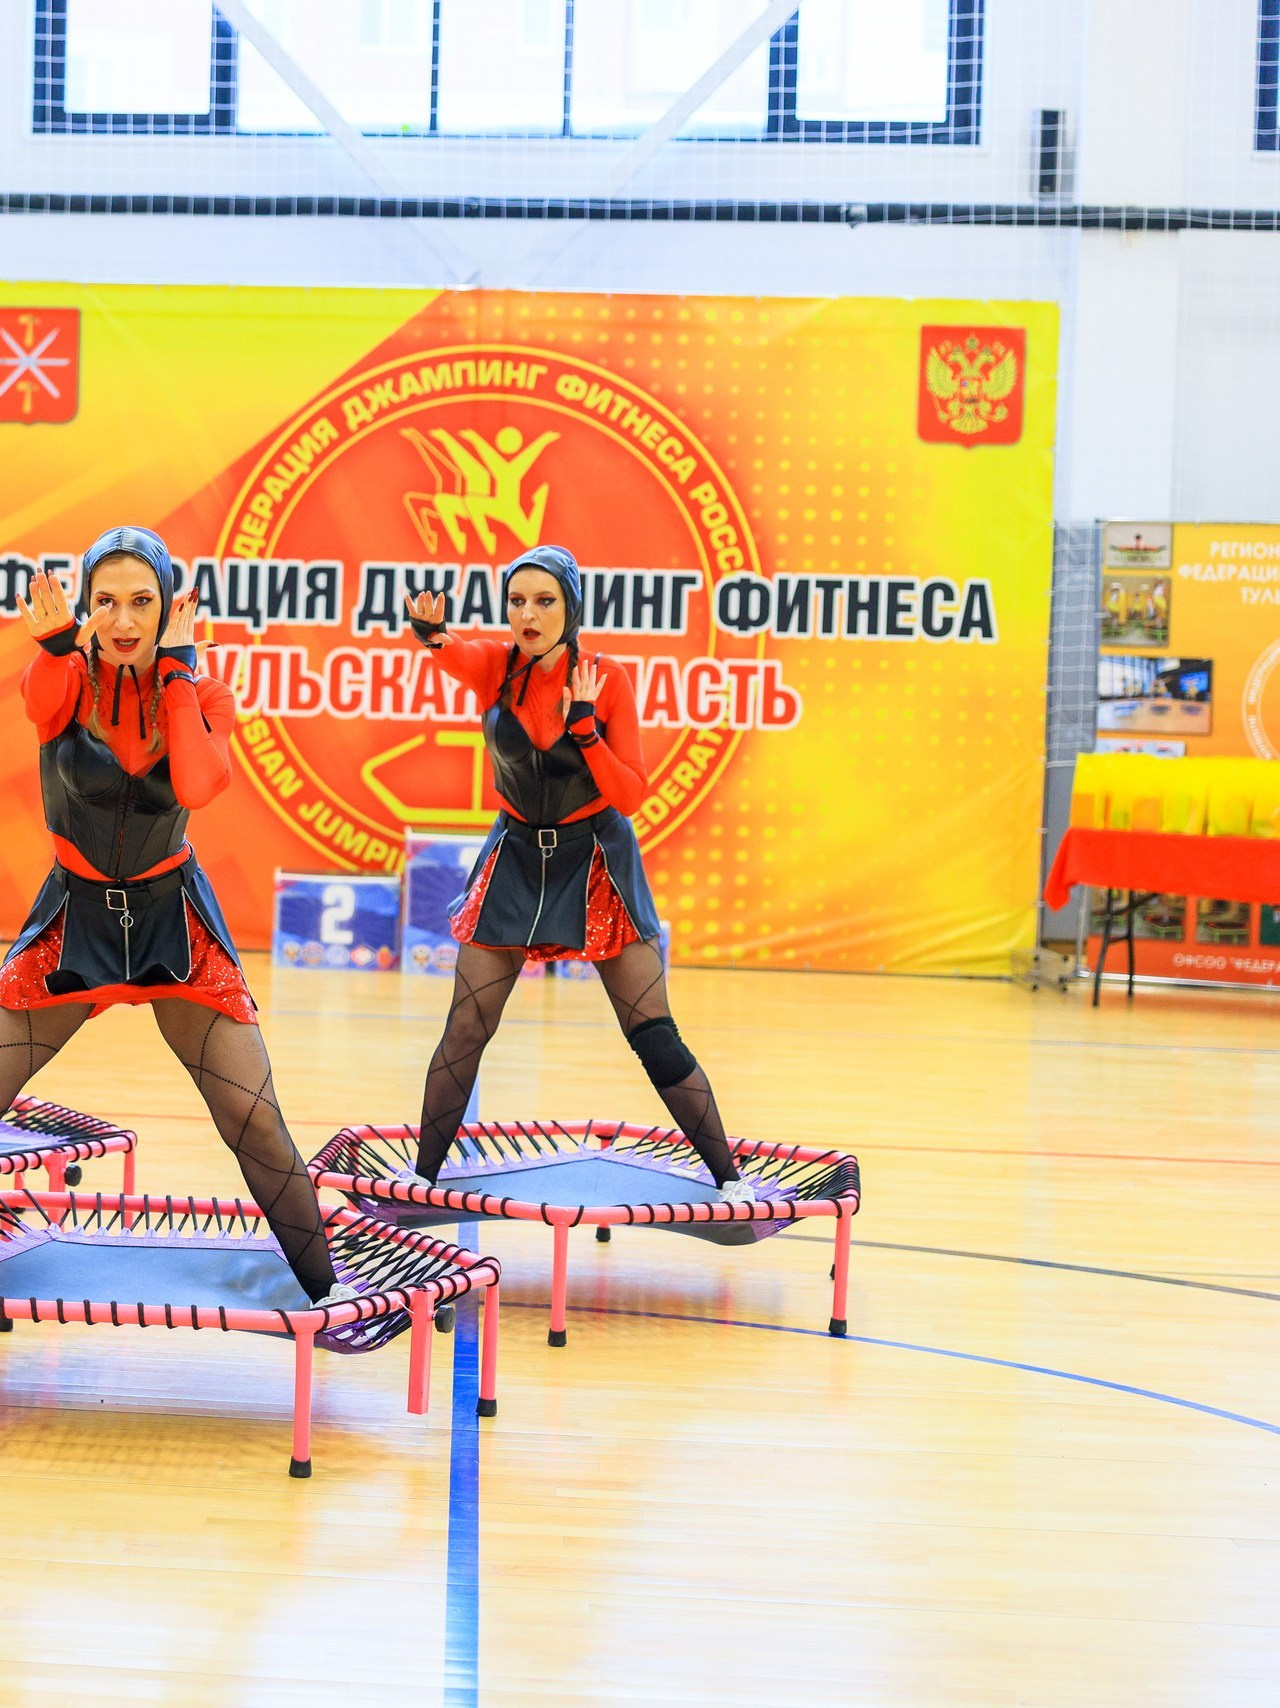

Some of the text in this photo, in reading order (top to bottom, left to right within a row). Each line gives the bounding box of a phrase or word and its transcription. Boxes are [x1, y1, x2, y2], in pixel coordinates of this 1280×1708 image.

[233, 359, 745, 577] ДЕРАЦИЯ ДЖАМПИНГ ФИТНЕСА РОСС
[357, 566, 695, 632] ДЖАИНГ
[718, 576, 995, 640] ФИТНЕСА
[613, 663, 798, 726] АСТЬ
[297, 801, 405, 874] JUMPI
[631, 728, 724, 839] EDERAT
[320, 884, 356, 945] 2
